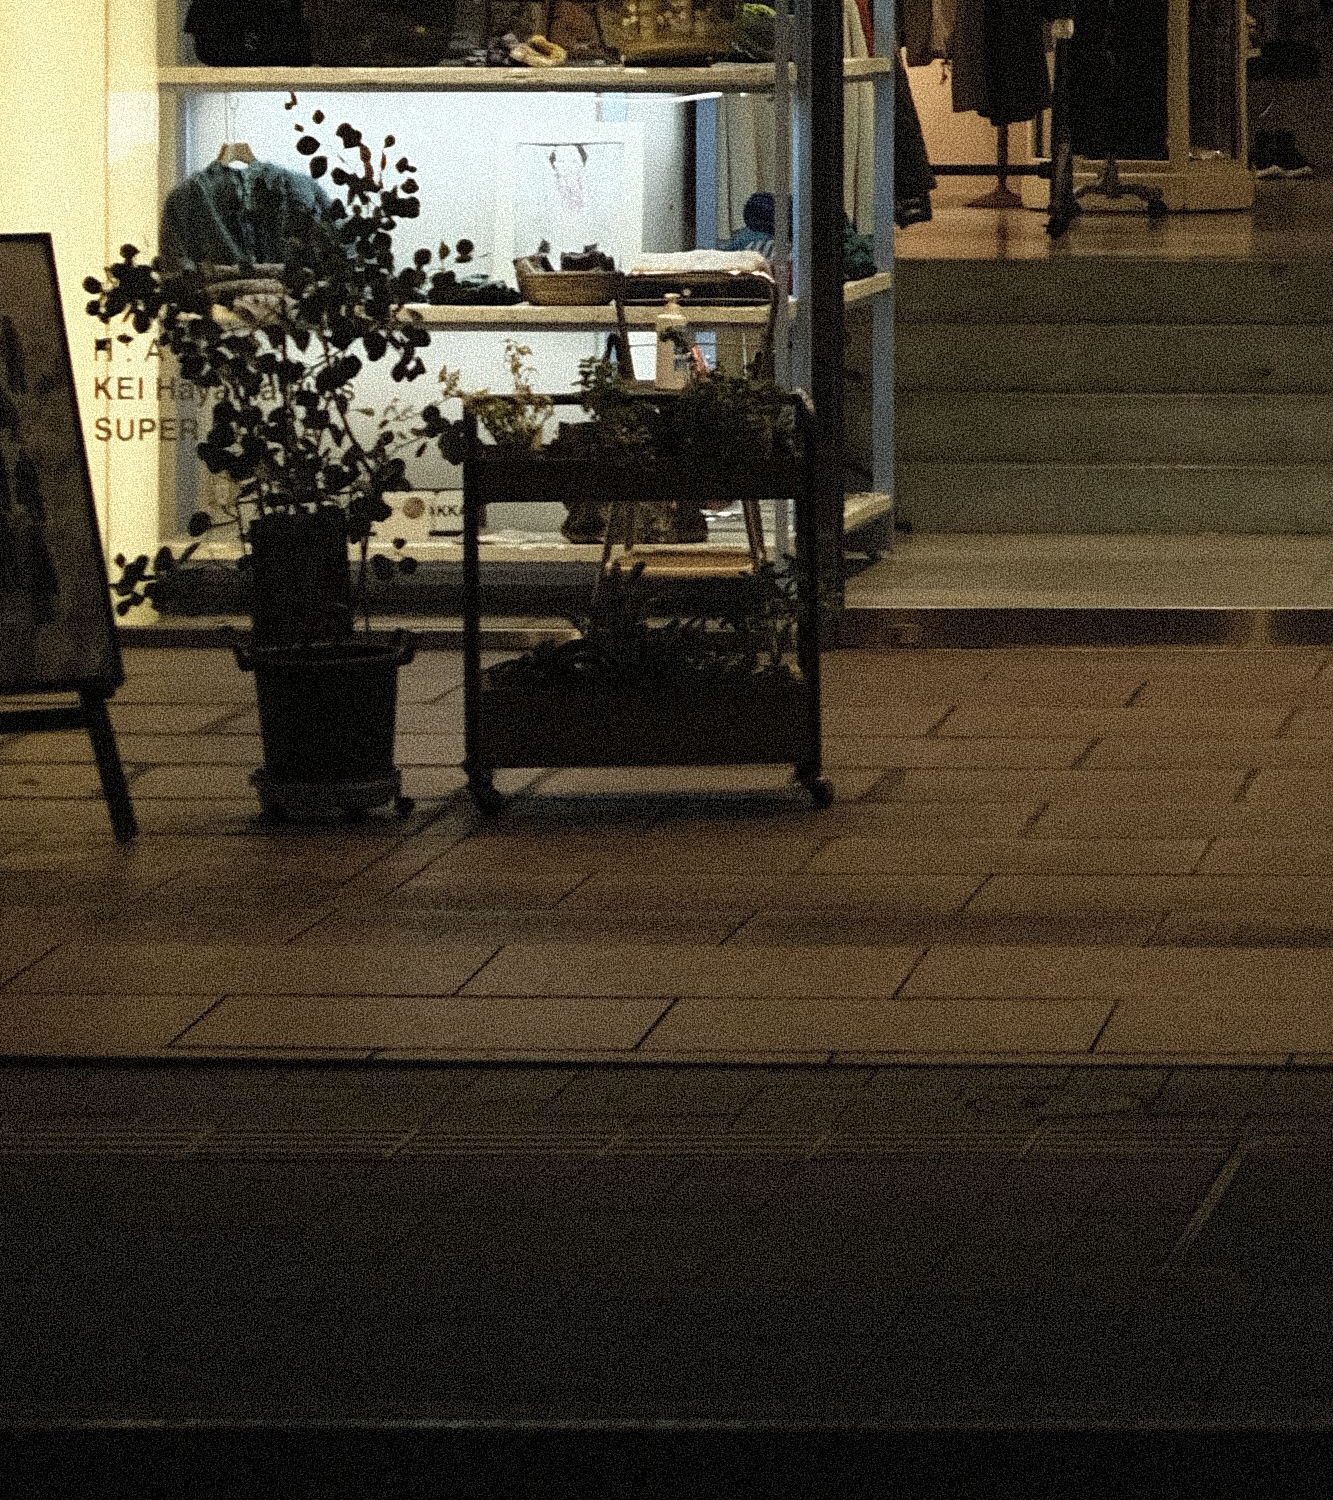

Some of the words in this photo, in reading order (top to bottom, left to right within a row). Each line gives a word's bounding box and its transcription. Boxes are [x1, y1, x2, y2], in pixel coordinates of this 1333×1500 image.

[94, 376, 144, 400] KEI
[156, 376, 277, 409] Hayaa
[94, 416, 199, 442] SUPER
